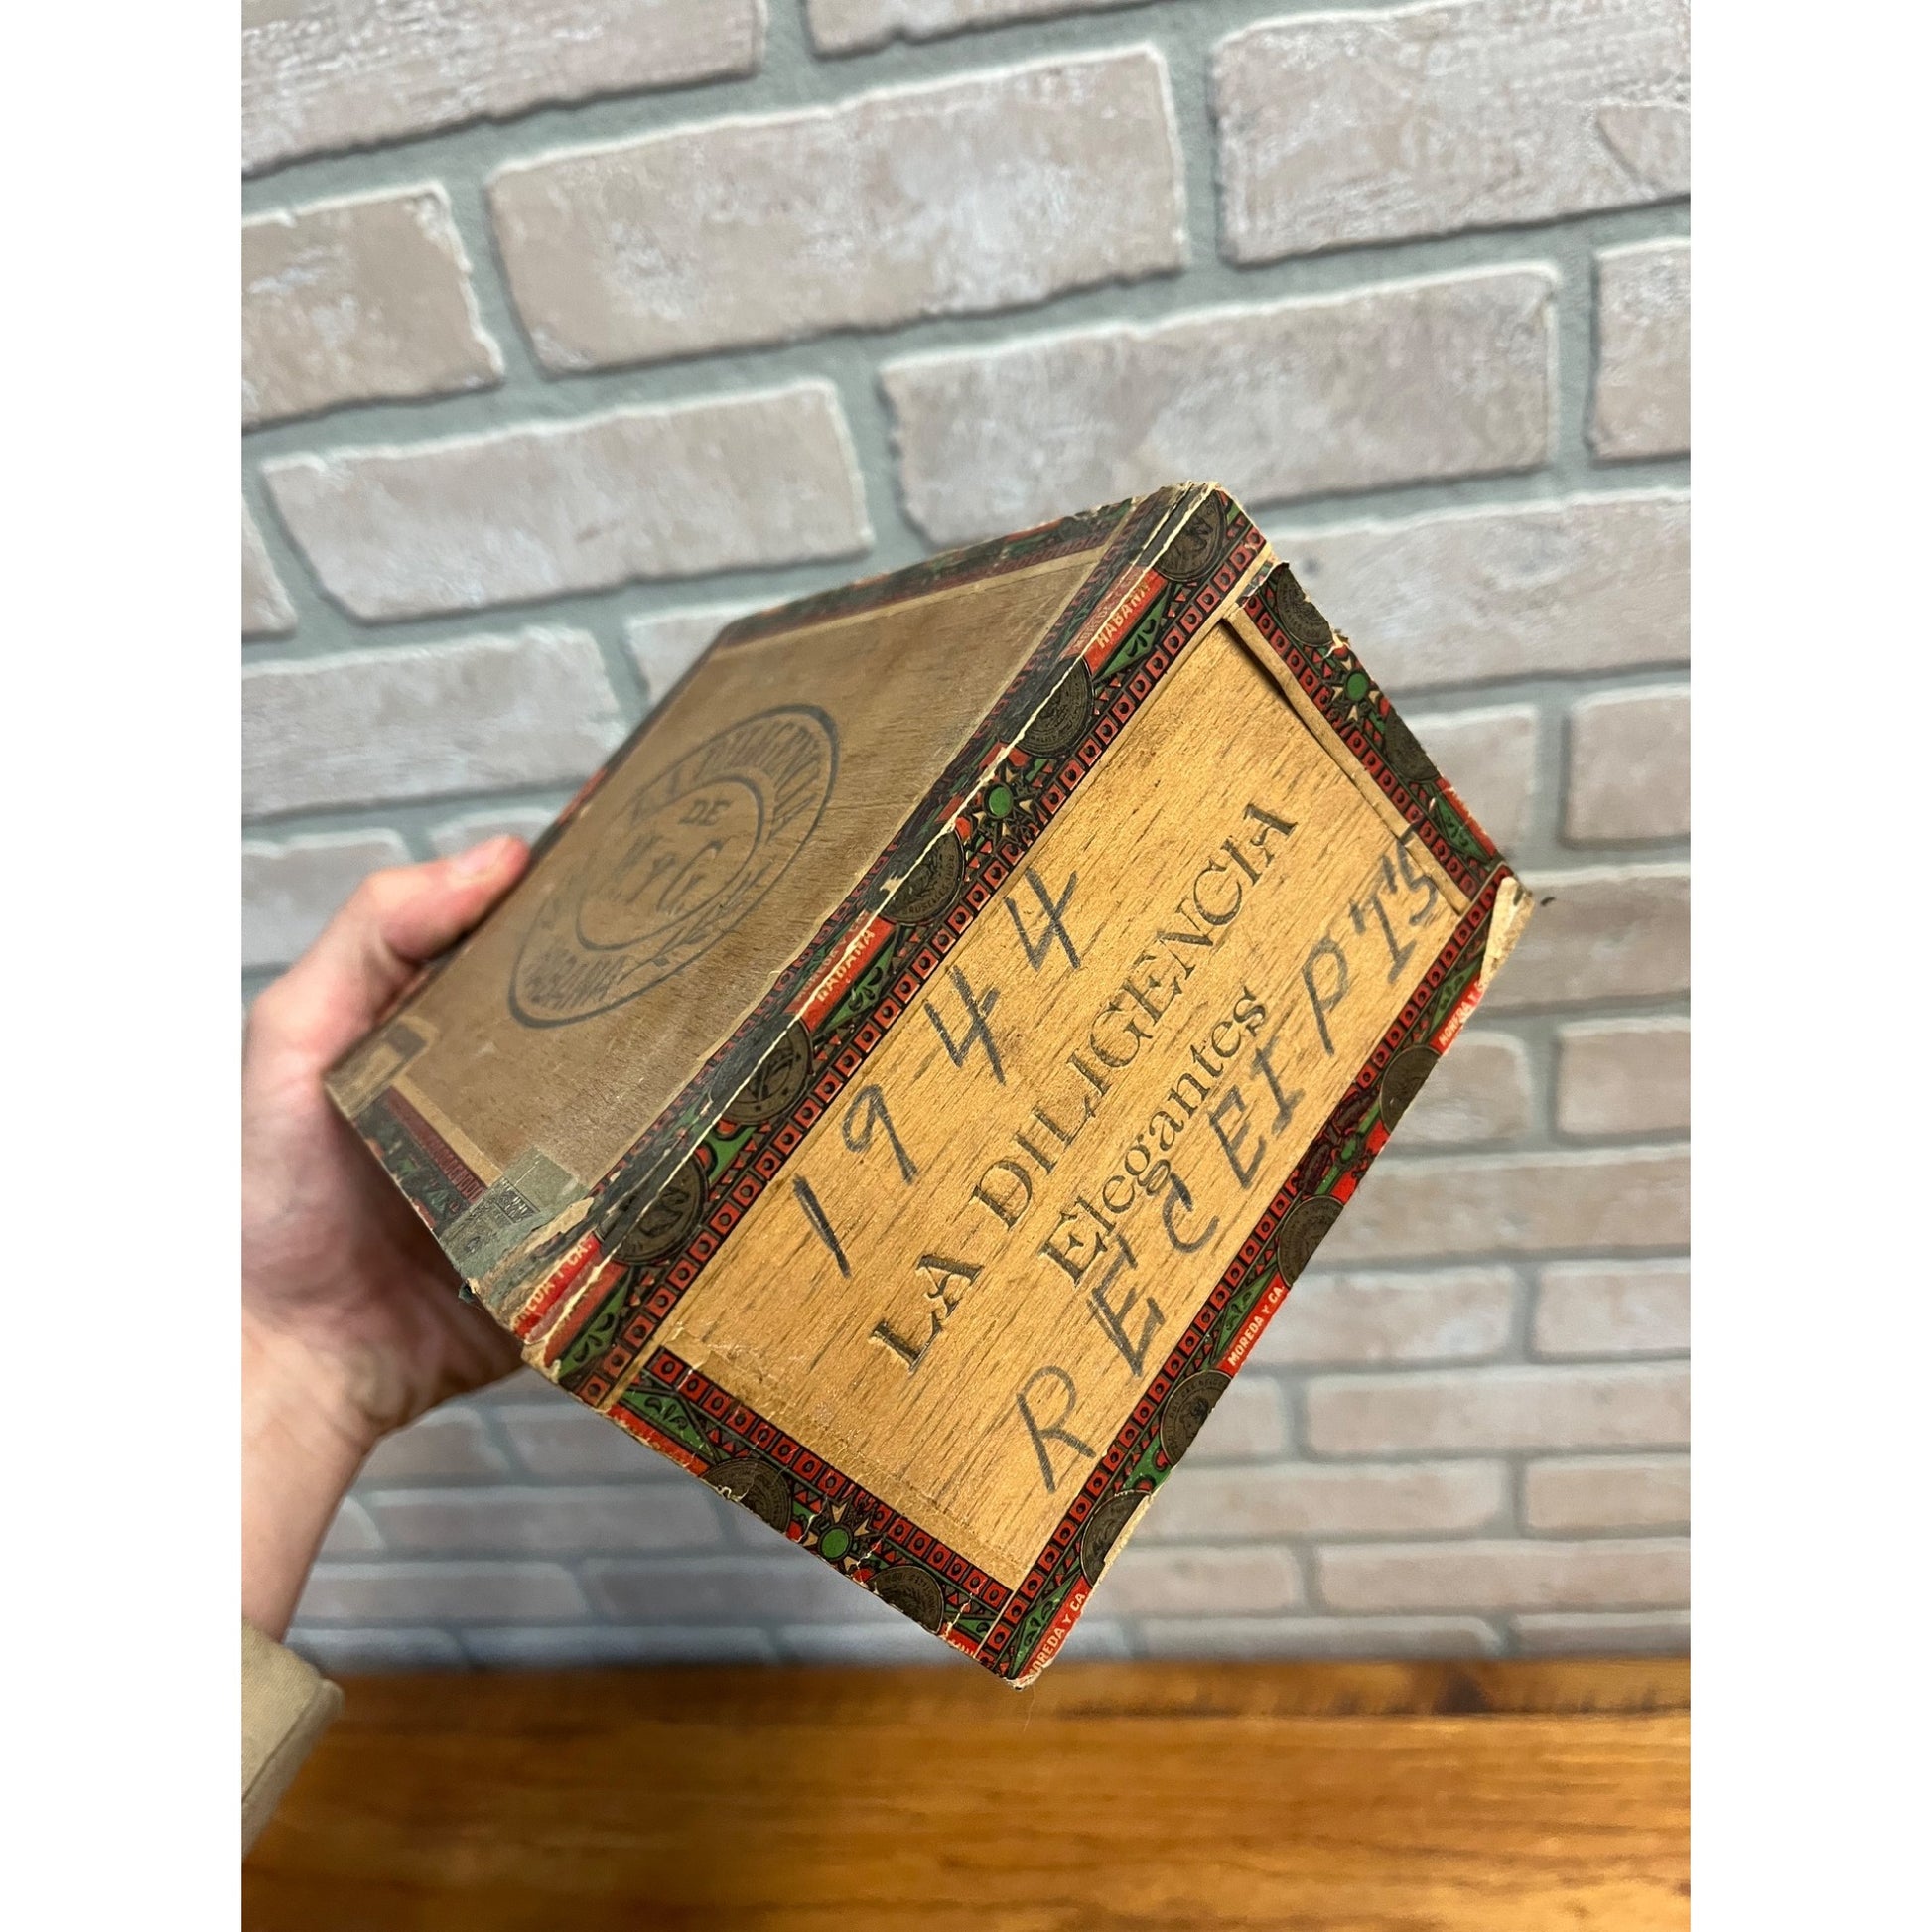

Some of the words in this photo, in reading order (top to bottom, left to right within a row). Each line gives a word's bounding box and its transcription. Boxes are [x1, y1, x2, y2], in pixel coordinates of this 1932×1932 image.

[1095, 583, 1151, 649] HABANA
[677, 797, 733, 827] DE
[871, 1251, 982, 1374] LA
[969, 801, 1300, 1231] DILIGENCIA
[1037, 985, 1272, 1289] Elegantes
[1226, 1314, 1264, 1367] MOREDA
[1260, 1304, 1273, 1315] Y
[1060, 1613, 1073, 1626] Y
